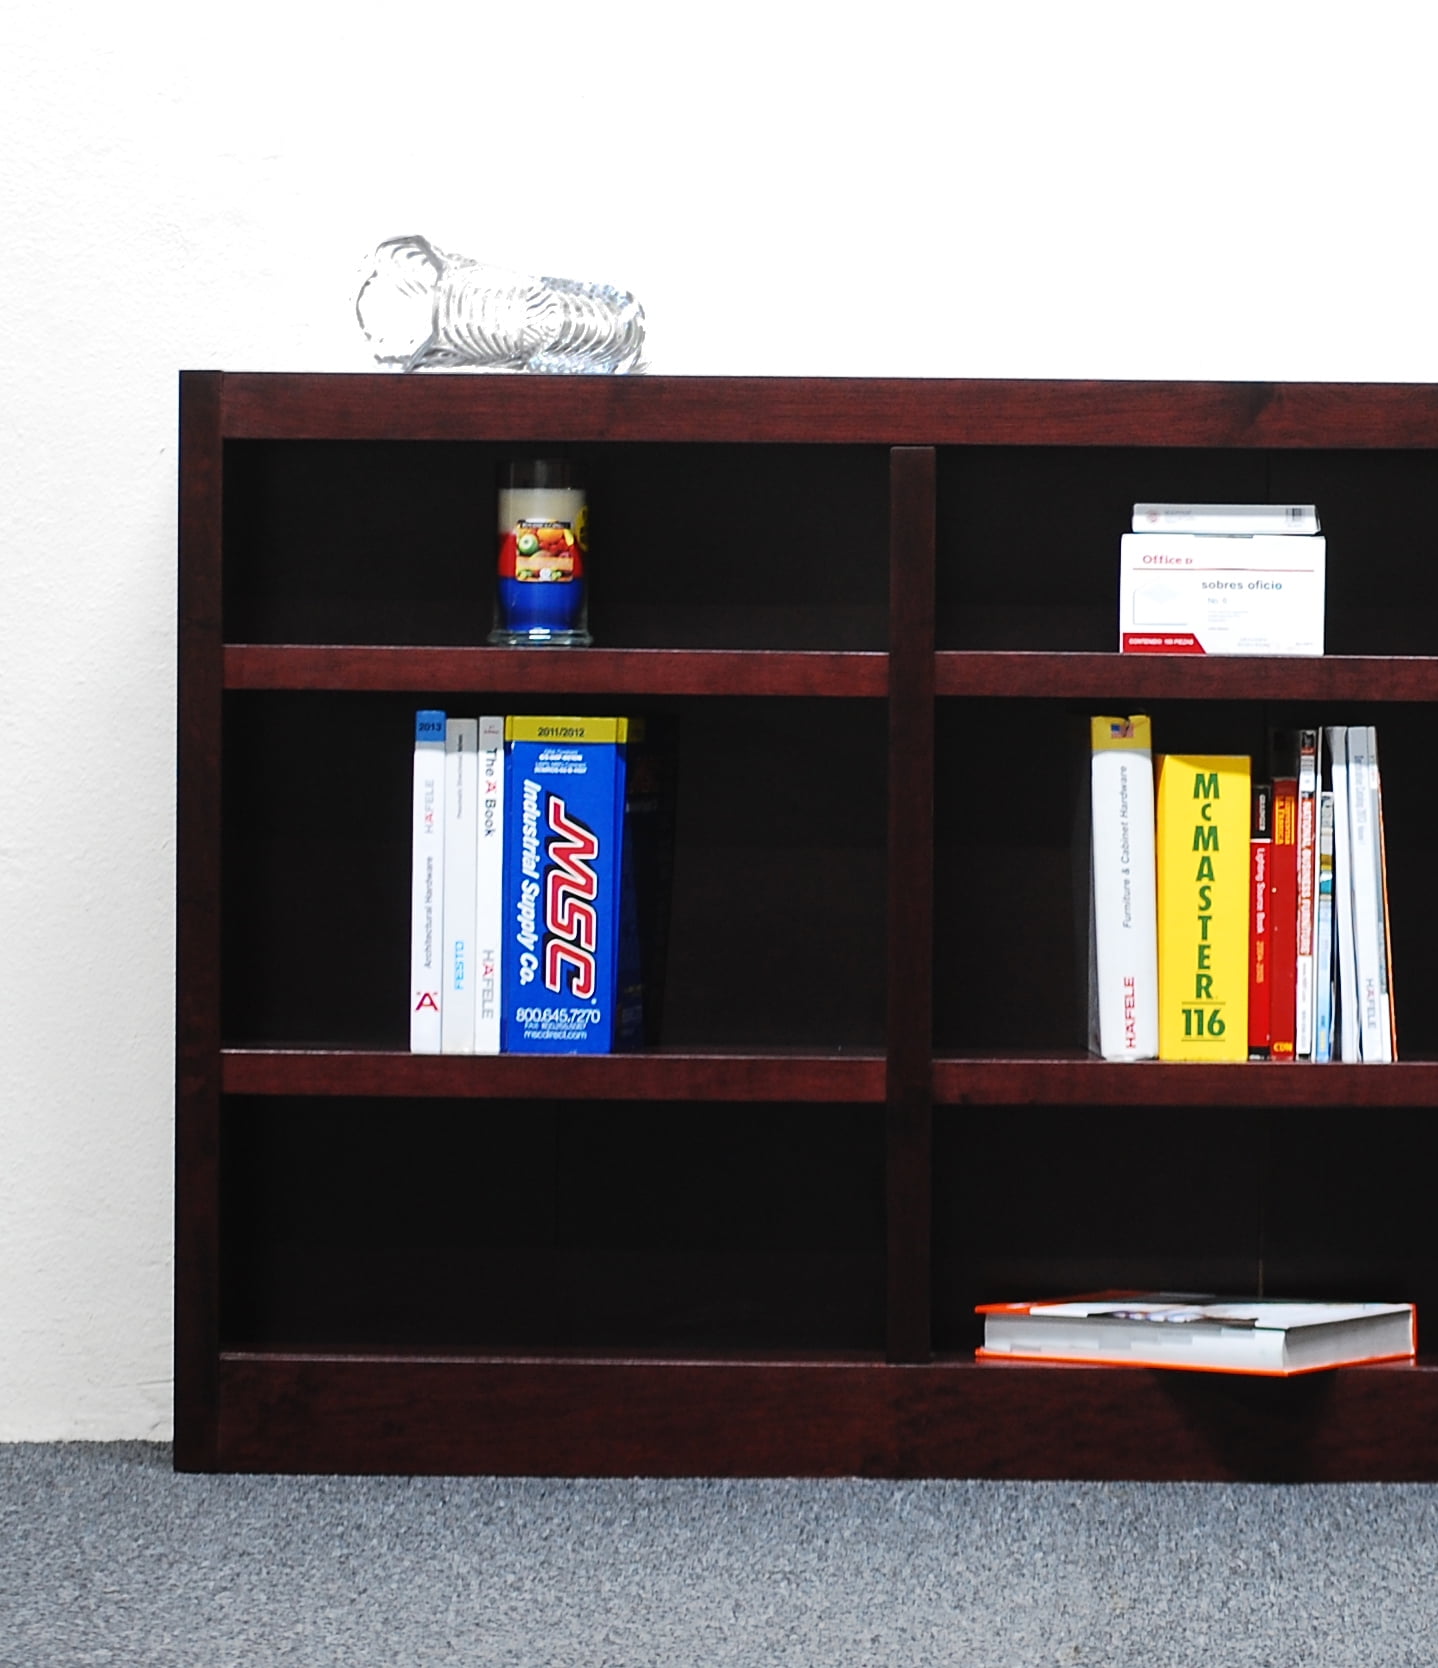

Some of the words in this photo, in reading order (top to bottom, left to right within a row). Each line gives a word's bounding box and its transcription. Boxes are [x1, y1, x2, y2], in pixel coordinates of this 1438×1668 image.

[1142, 554, 1183, 565] Office
[1201, 580, 1244, 591] sobres
[1247, 580, 1283, 591] oficio
[418, 721, 442, 733] 2013
[537, 725, 586, 739] 2011/2012
[486, 748, 498, 777] The
[1118, 765, 1129, 819] Hardware
[484, 799, 497, 837] Book
[522, 778, 542, 880] Industrial
[1120, 821, 1130, 865] Cabinet
[425, 855, 433, 901] Hardware
[1254, 847, 1266, 882] Lighting
[516, 878, 540, 951] Supply
[547, 795, 599, 1000] MSC
[1121, 878, 1133, 929] Furniture
[1255, 882, 1265, 911] Source
[1255, 911, 1265, 935] Book
[454, 940, 465, 991] FESTO
[519, 951, 540, 987] Co.
[1181, 1007, 1227, 1038] 116
